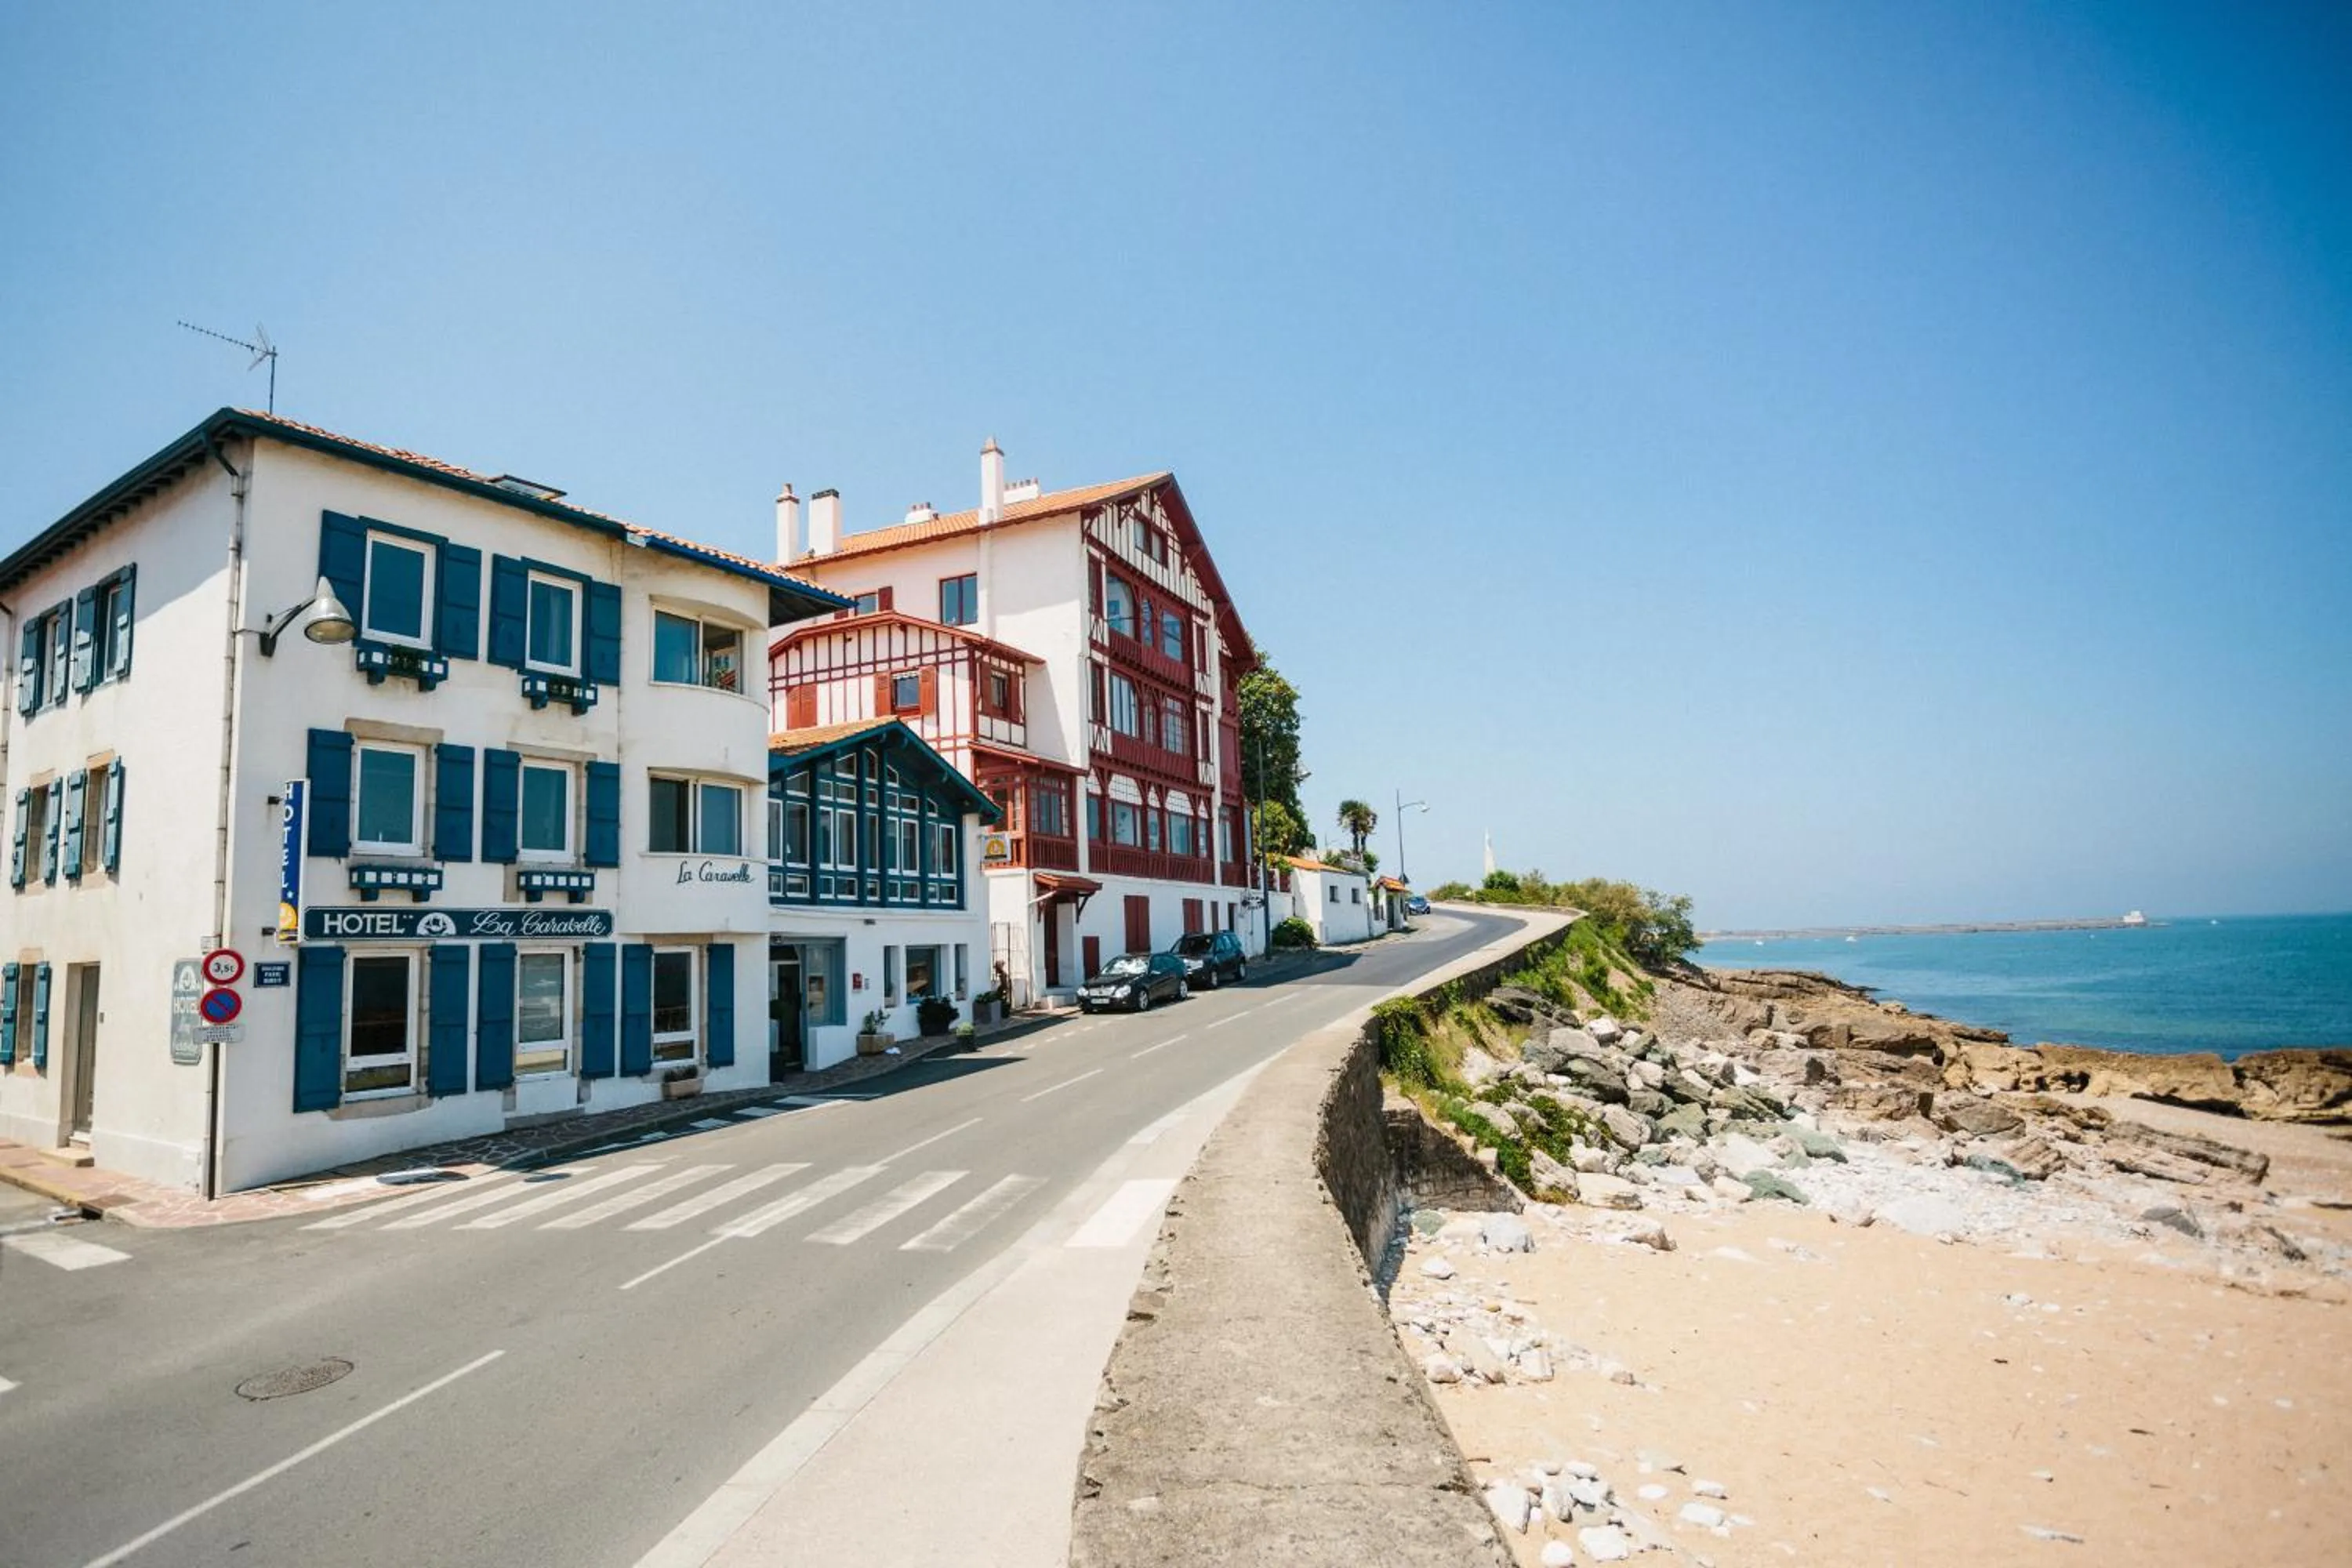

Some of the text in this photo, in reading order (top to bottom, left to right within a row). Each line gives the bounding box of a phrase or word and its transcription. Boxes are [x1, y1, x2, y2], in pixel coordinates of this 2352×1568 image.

[279, 782, 294, 890] HOTEL
[677, 860, 757, 884] La Caravelle
[323, 913, 608, 936] HOTEL La Caravelle
[173, 996, 199, 1014] HOTEL
